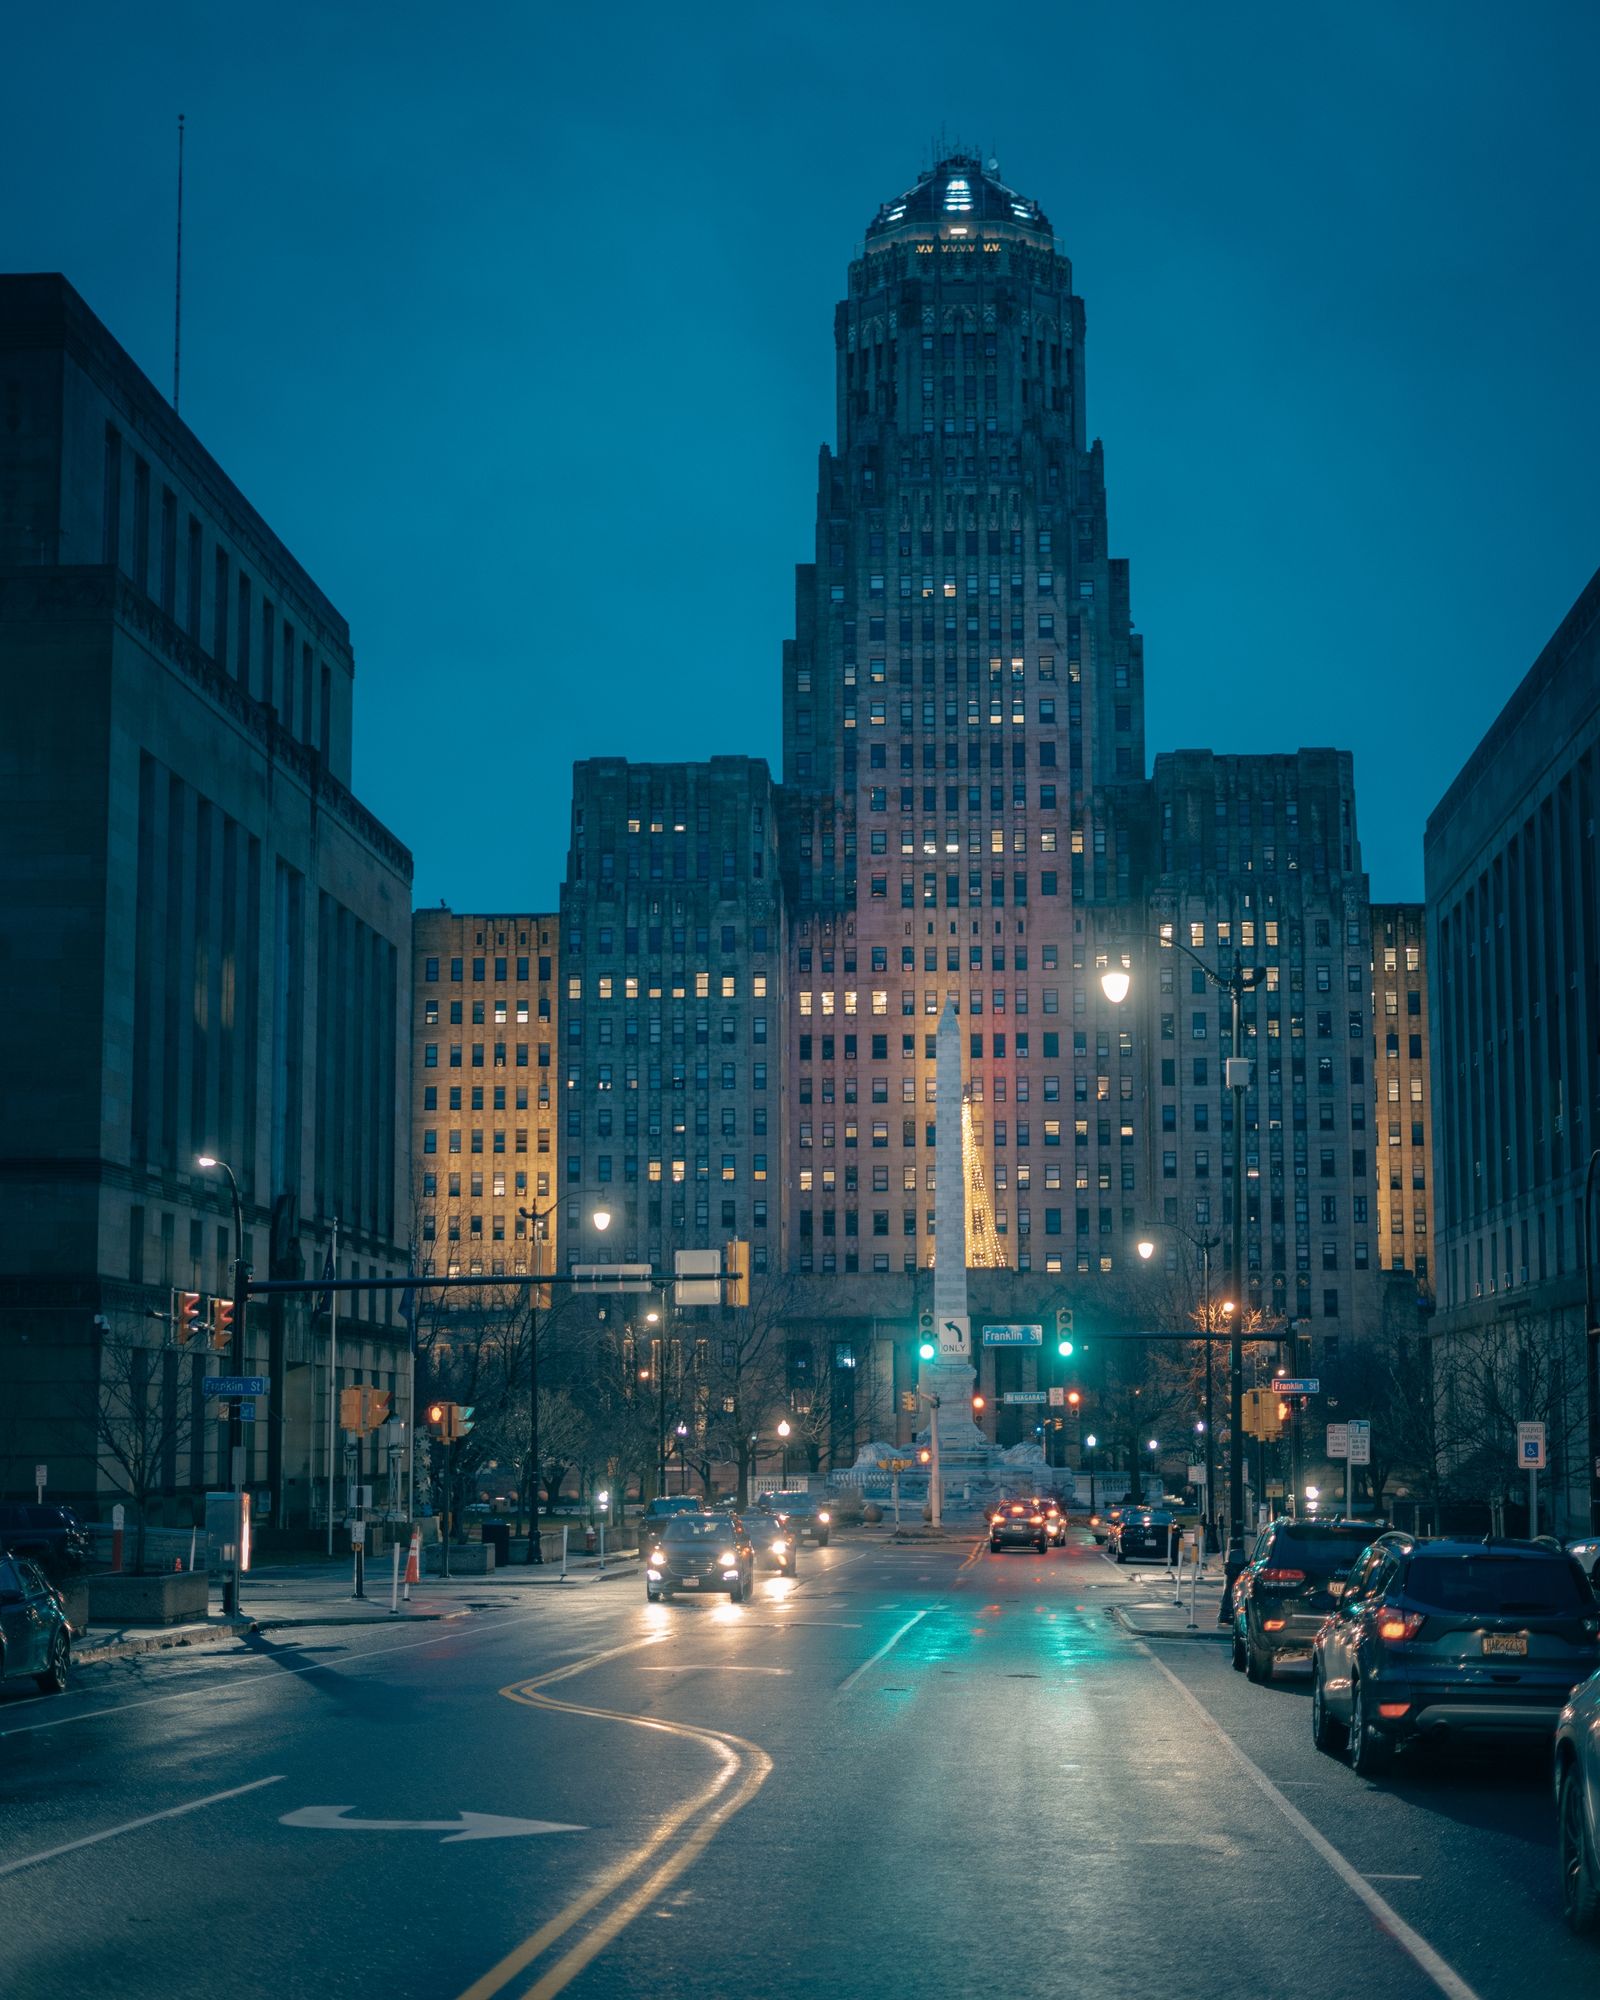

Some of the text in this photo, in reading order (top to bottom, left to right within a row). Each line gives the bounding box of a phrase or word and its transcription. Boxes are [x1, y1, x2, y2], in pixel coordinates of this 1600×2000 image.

[985, 1330, 1041, 1341] Franklin St
[943, 1344, 966, 1352] ONLY
[206, 1381, 261, 1392] Franklin St
[1275, 1381, 1317, 1390] Franklin St
